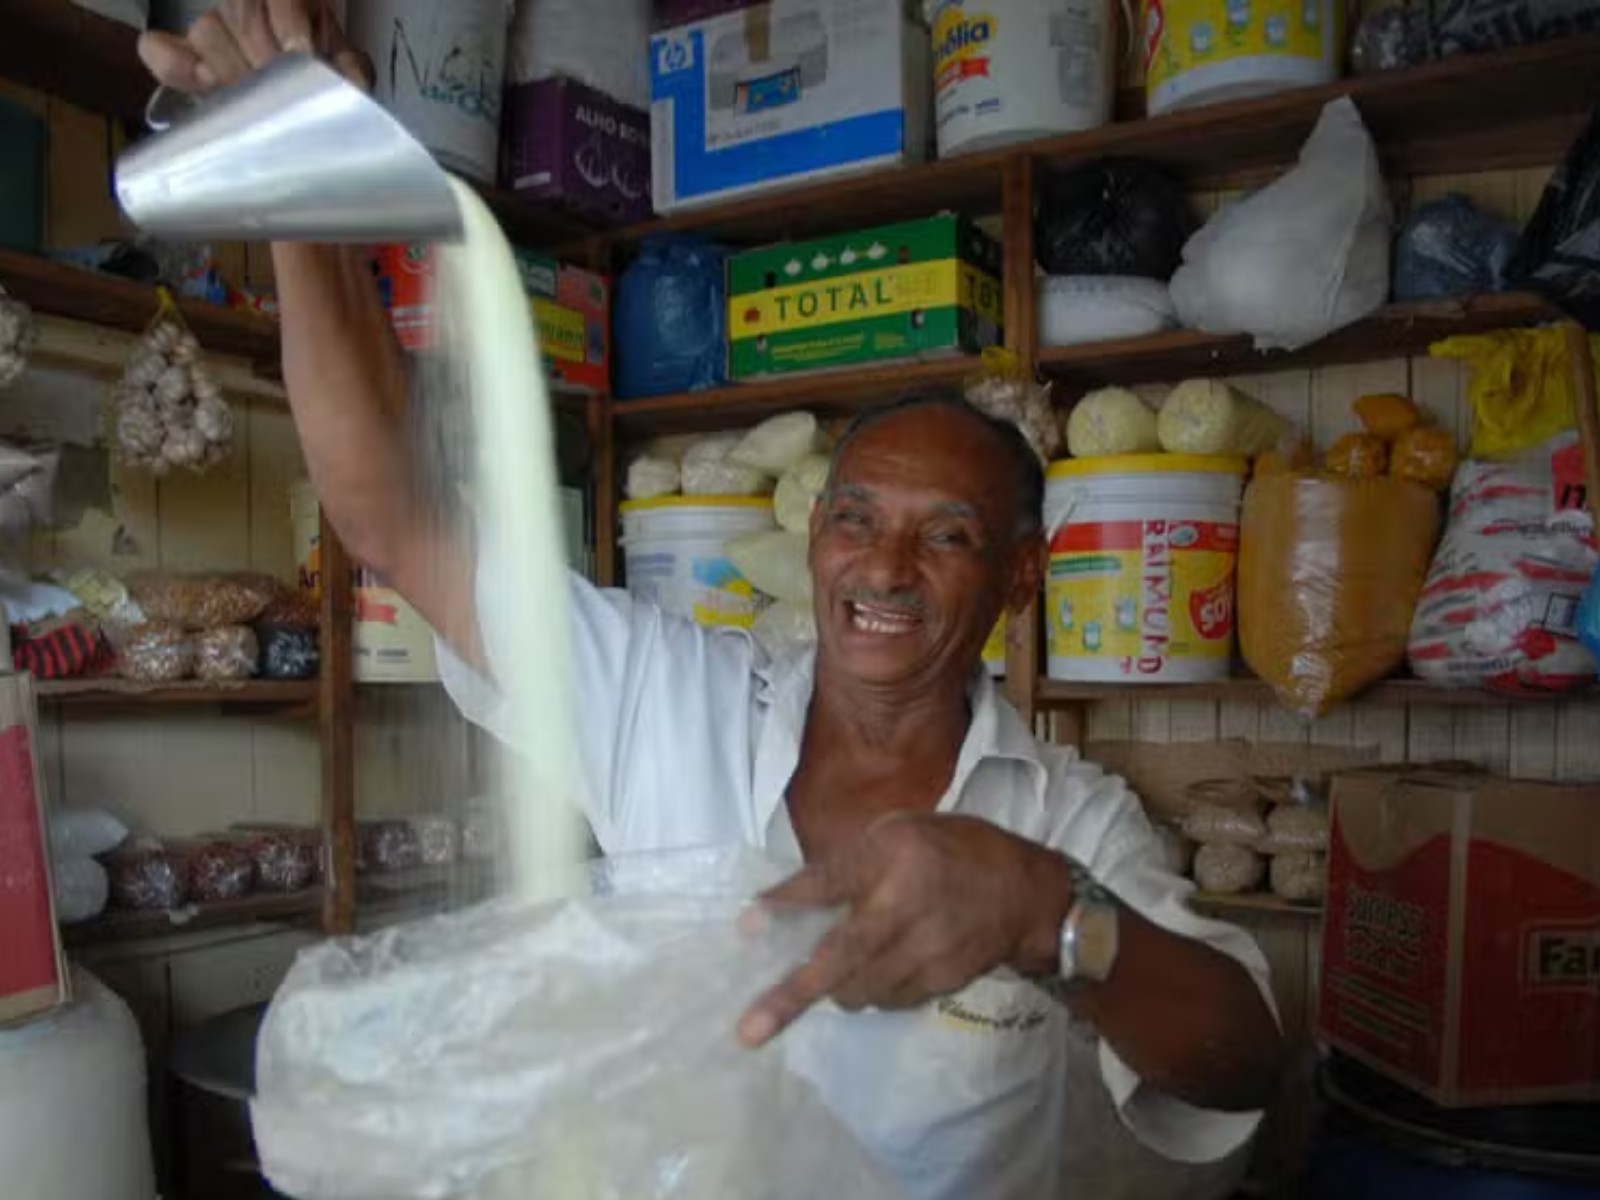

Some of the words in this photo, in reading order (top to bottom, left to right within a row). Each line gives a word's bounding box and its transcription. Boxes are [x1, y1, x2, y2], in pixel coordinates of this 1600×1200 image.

[575, 105, 616, 135] ALHO
[774, 278, 893, 322] TOTAL
[1538, 935, 1600, 976] Fa
